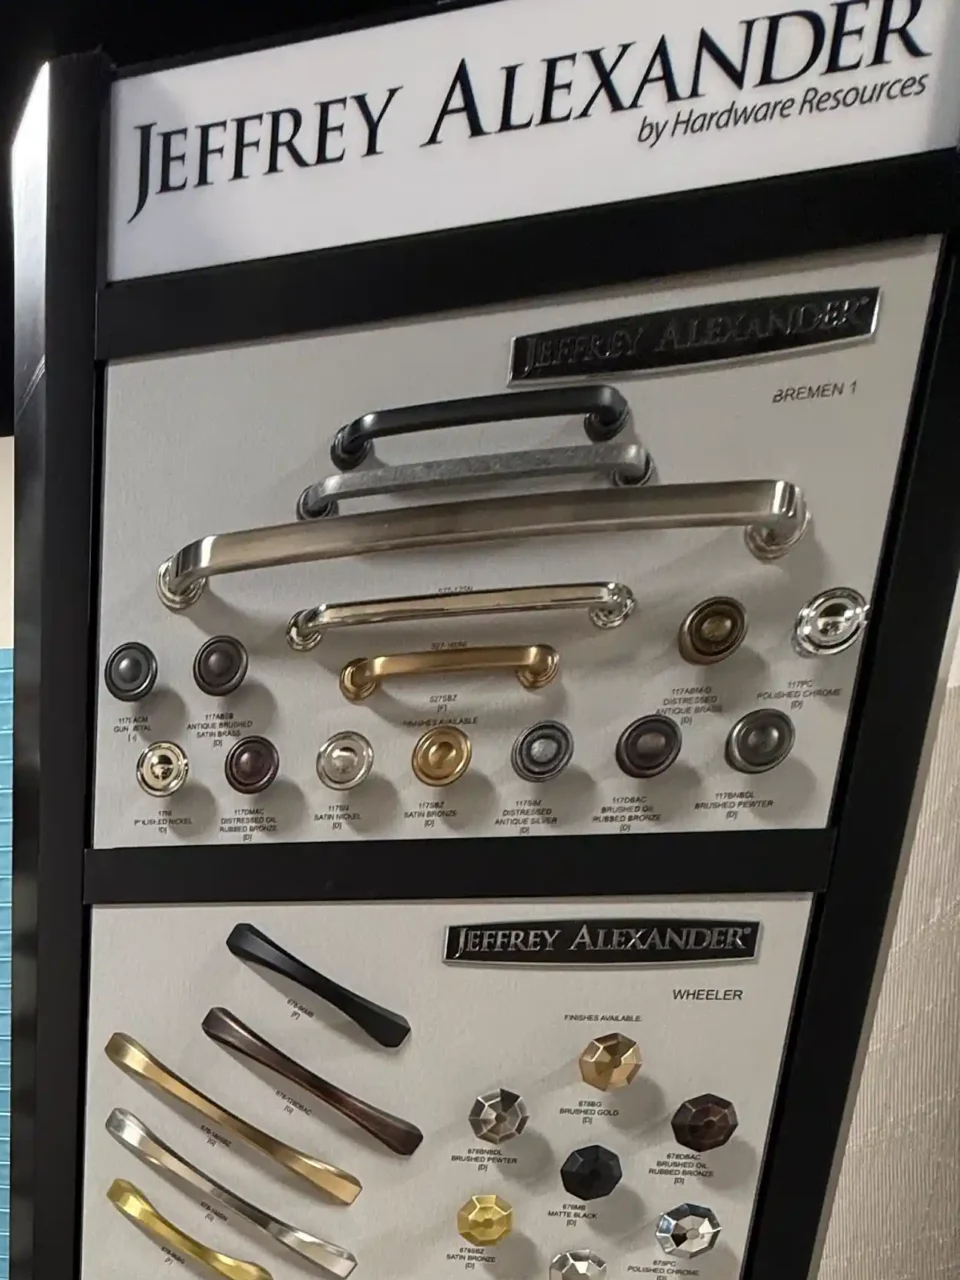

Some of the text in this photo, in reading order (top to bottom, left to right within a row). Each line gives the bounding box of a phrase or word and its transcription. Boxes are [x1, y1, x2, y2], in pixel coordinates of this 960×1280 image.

[127, 0, 933, 223] JEFFREY ALEXANDER
[637, 71, 930, 148] by Hardware Resources
[520, 300, 863, 378] JEFFREY ALEXANDER
[772, 381, 857, 403] BREMEN 1
[756, 690, 801, 700] POLISHED
[113, 725, 129, 734] GUN
[186, 720, 254, 730] ANTIQUE BRUSHED
[196, 730, 216, 739] SATIN
[694, 799, 774, 810] BRUSHED PEWTER
[313, 813, 335, 821] SATIN
[403, 809, 457, 818] SATIN BRONZE
[494, 817, 529, 826] ANTIQUE
[452, 923, 747, 959] JEFFREY ALEXANDER
[672, 988, 744, 1001] WHEELER
[563, 1014, 599, 1022] FINISHES
[559, 1107, 620, 1117] BRUSHED GOLD
[450, 1155, 518, 1165] BRUSHED PEWTER
[656, 1160, 695, 1168] BRUSHED
[547, 1210, 573, 1218] MATTE
[446, 1253, 497, 1263] SATIN BRONZE
[627, 1265, 700, 1276] POLISHED CHROME
